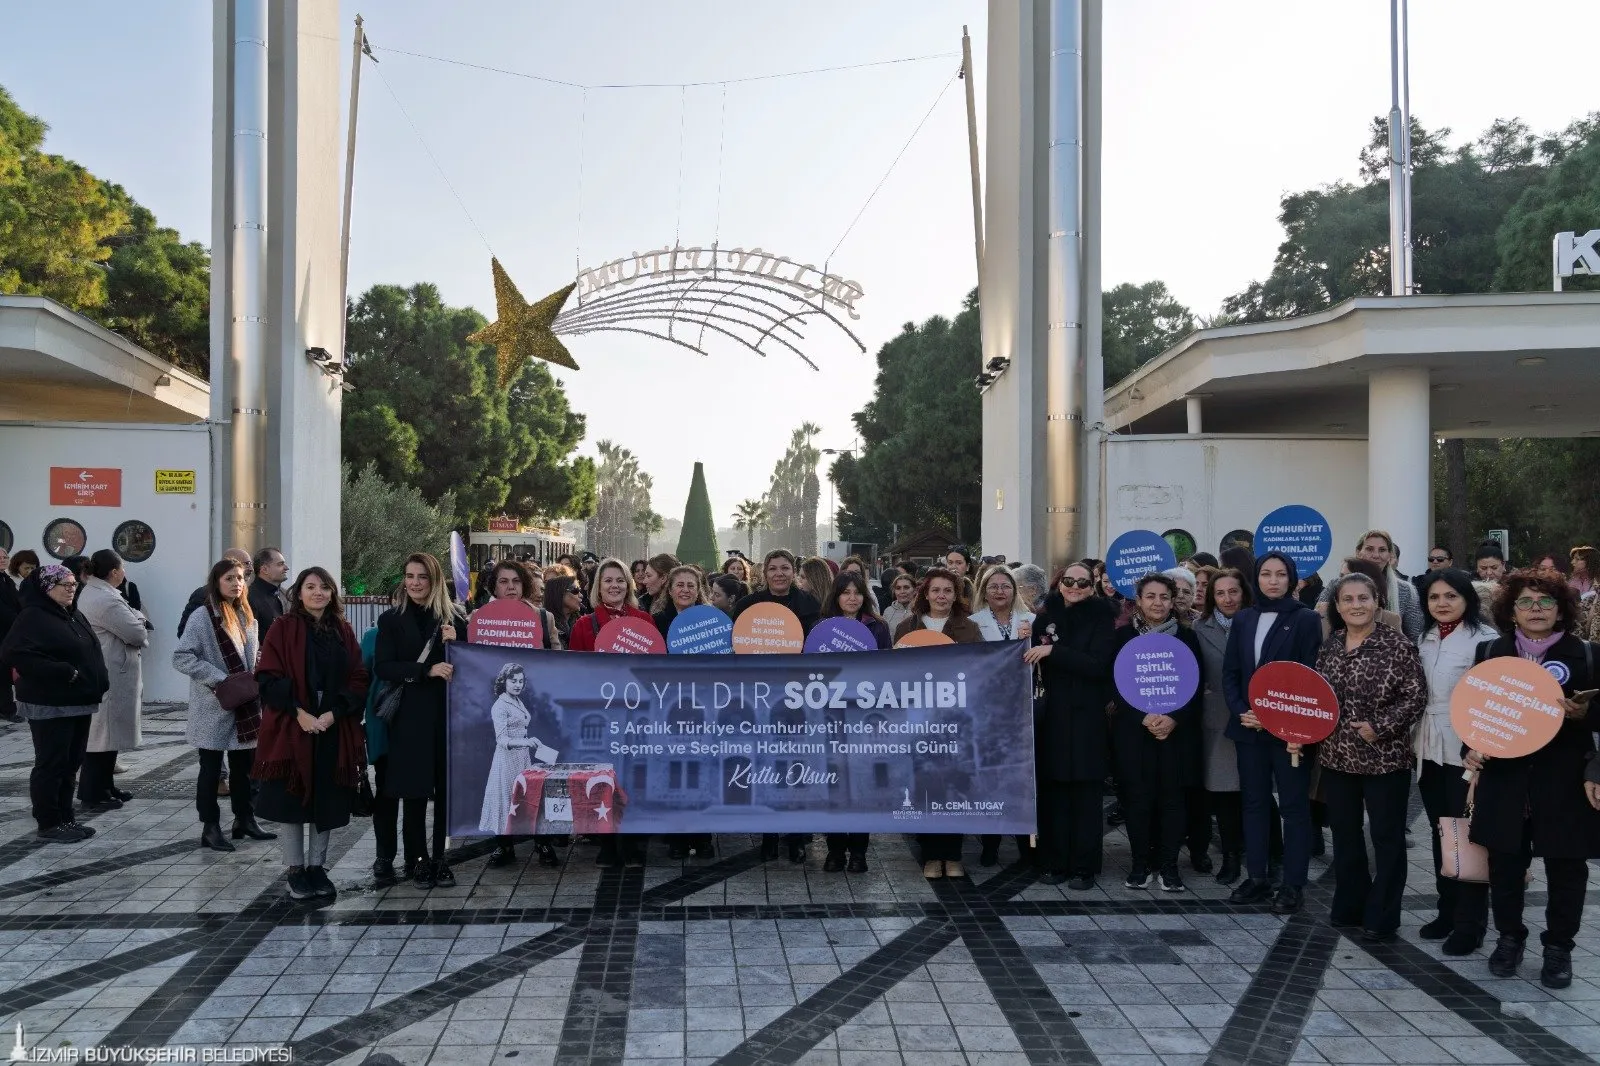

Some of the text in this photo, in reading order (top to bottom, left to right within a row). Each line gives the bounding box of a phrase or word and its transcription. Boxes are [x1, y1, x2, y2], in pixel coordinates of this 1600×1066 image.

[1262, 523, 1323, 534] CUMHURİYET
[1119, 545, 1155, 555] HAKLARIMI
[1267, 544, 1318, 553] KADINLARI
[1115, 554, 1163, 567] BİLİYORUM,
[476, 617, 536, 628] CUMHURİYETİMİZ
[678, 617, 719, 634] HAKLARIMIZI
[476, 628, 534, 639] KADINLARLA
[670, 623, 733, 648] CUMHURİYETLE
[733, 635, 763, 646] SEÇME
[1134, 651, 1175, 660] YAŞAMDA
[1136, 661, 1176, 673] EŞİTLİK,
[1134, 674, 1180, 684] YÖNETİMDE
[1499, 674, 1535, 692] KADININ
[600, 672, 967, 710] 90 YILDIR SÖZ SAHİBİ
[1139, 684, 1177, 697] EŞİTLİK
[1267, 689, 1319, 705] HAKLARIMIZ
[1254, 697, 1334, 721] GÜCÜMÜZDÜR!
[1484, 699, 1523, 720] HAKKI
[609, 721, 620, 735] 5
[624, 720, 673, 735] Aralık
[676, 720, 735, 737] Türkiye
[878, 720, 958, 734] Kadınlara
[1471, 720, 1514, 741] SİGORTASI
[610, 740, 959, 757] Seçme ve Seçilme Hakkının Tanınması Günü
[728, 762, 839, 789] Kutlu Olsun
[553, 803, 566, 813] 87
[931, 800, 1004, 810] Dr. CEMİL TUGAY
